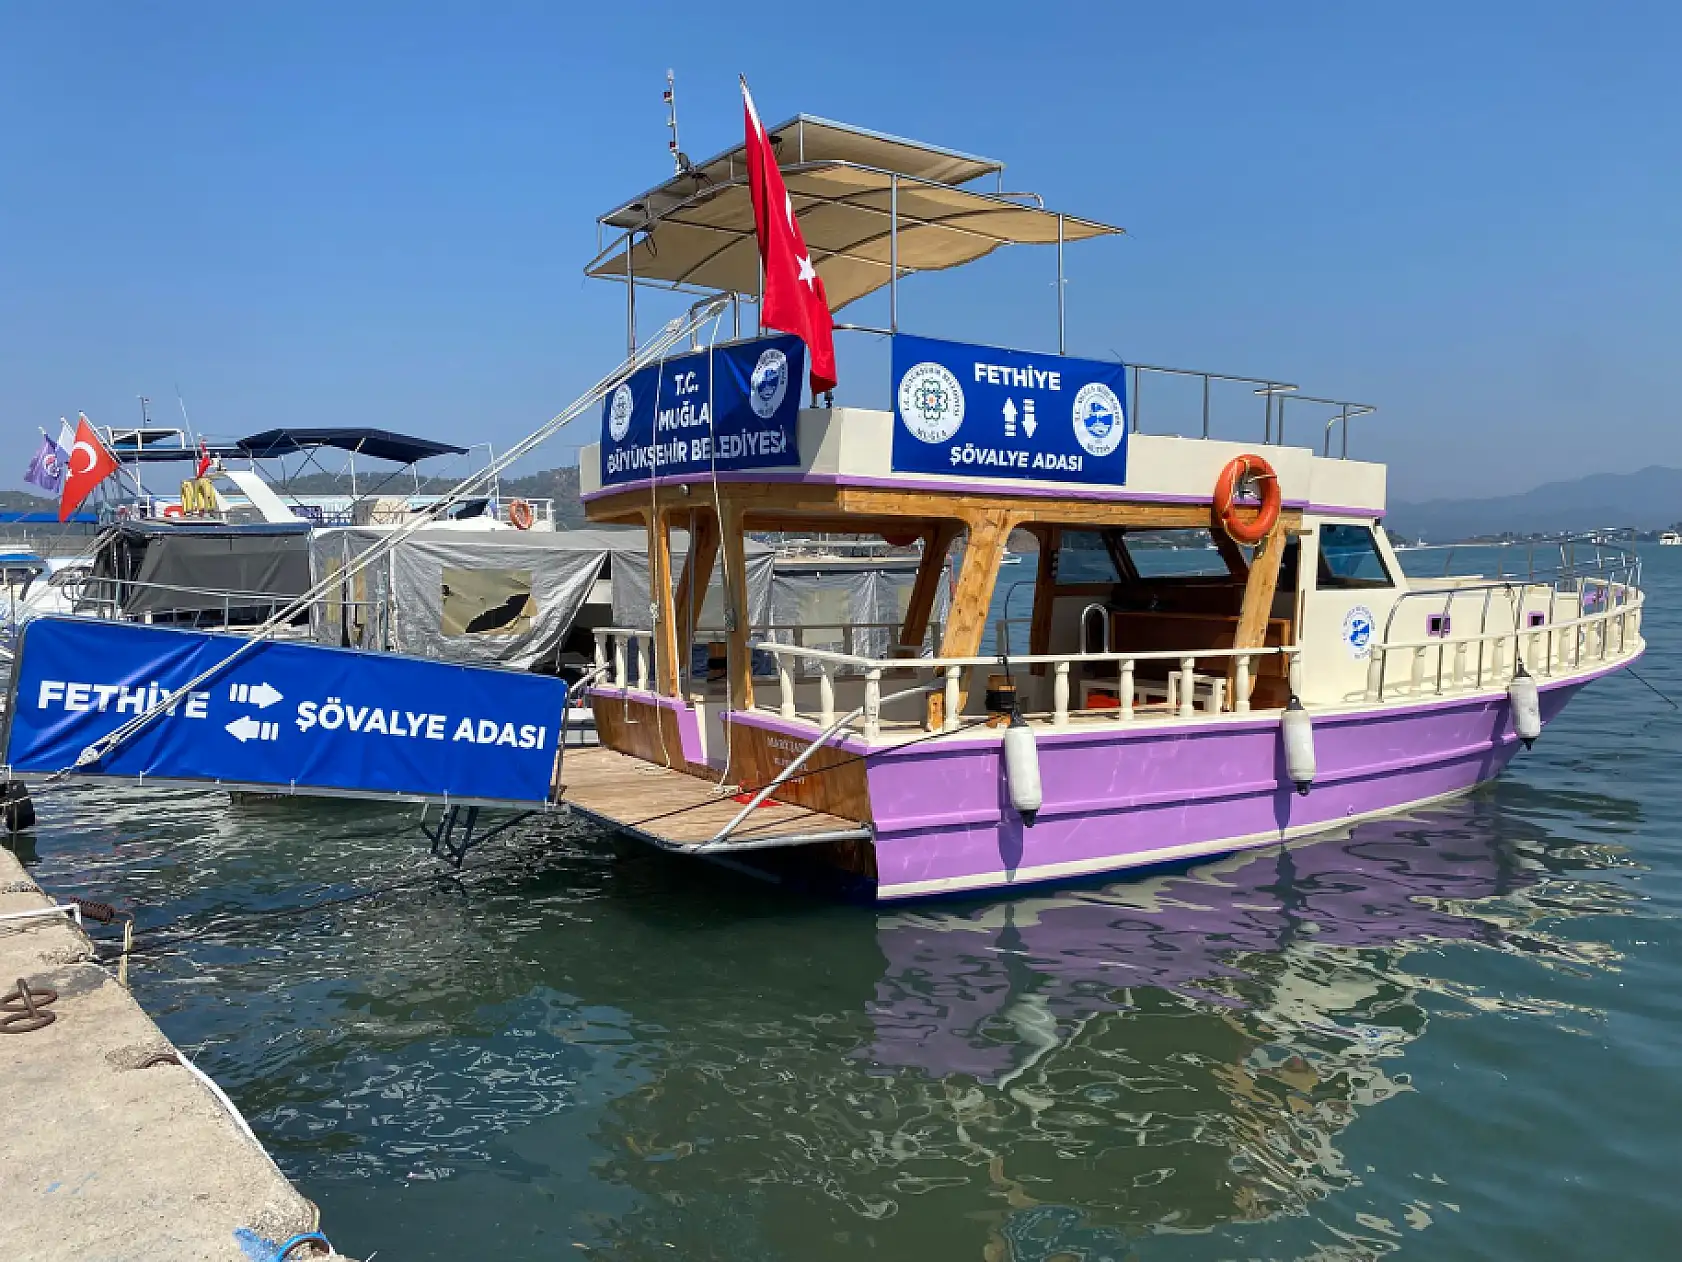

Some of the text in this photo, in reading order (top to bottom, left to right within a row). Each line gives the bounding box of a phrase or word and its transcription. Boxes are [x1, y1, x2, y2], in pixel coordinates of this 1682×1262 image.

[674, 371, 699, 396] T.C.
[974, 362, 1061, 391] FETHİYE
[658, 401, 710, 431] MUĞLA
[607, 425, 788, 474] BÜYÜKŞEHİR BELEDİYESİ
[950, 443, 1083, 471] ŞÖVALYE ADASI
[295, 696, 547, 749] ŞÖVALYE ADASI
